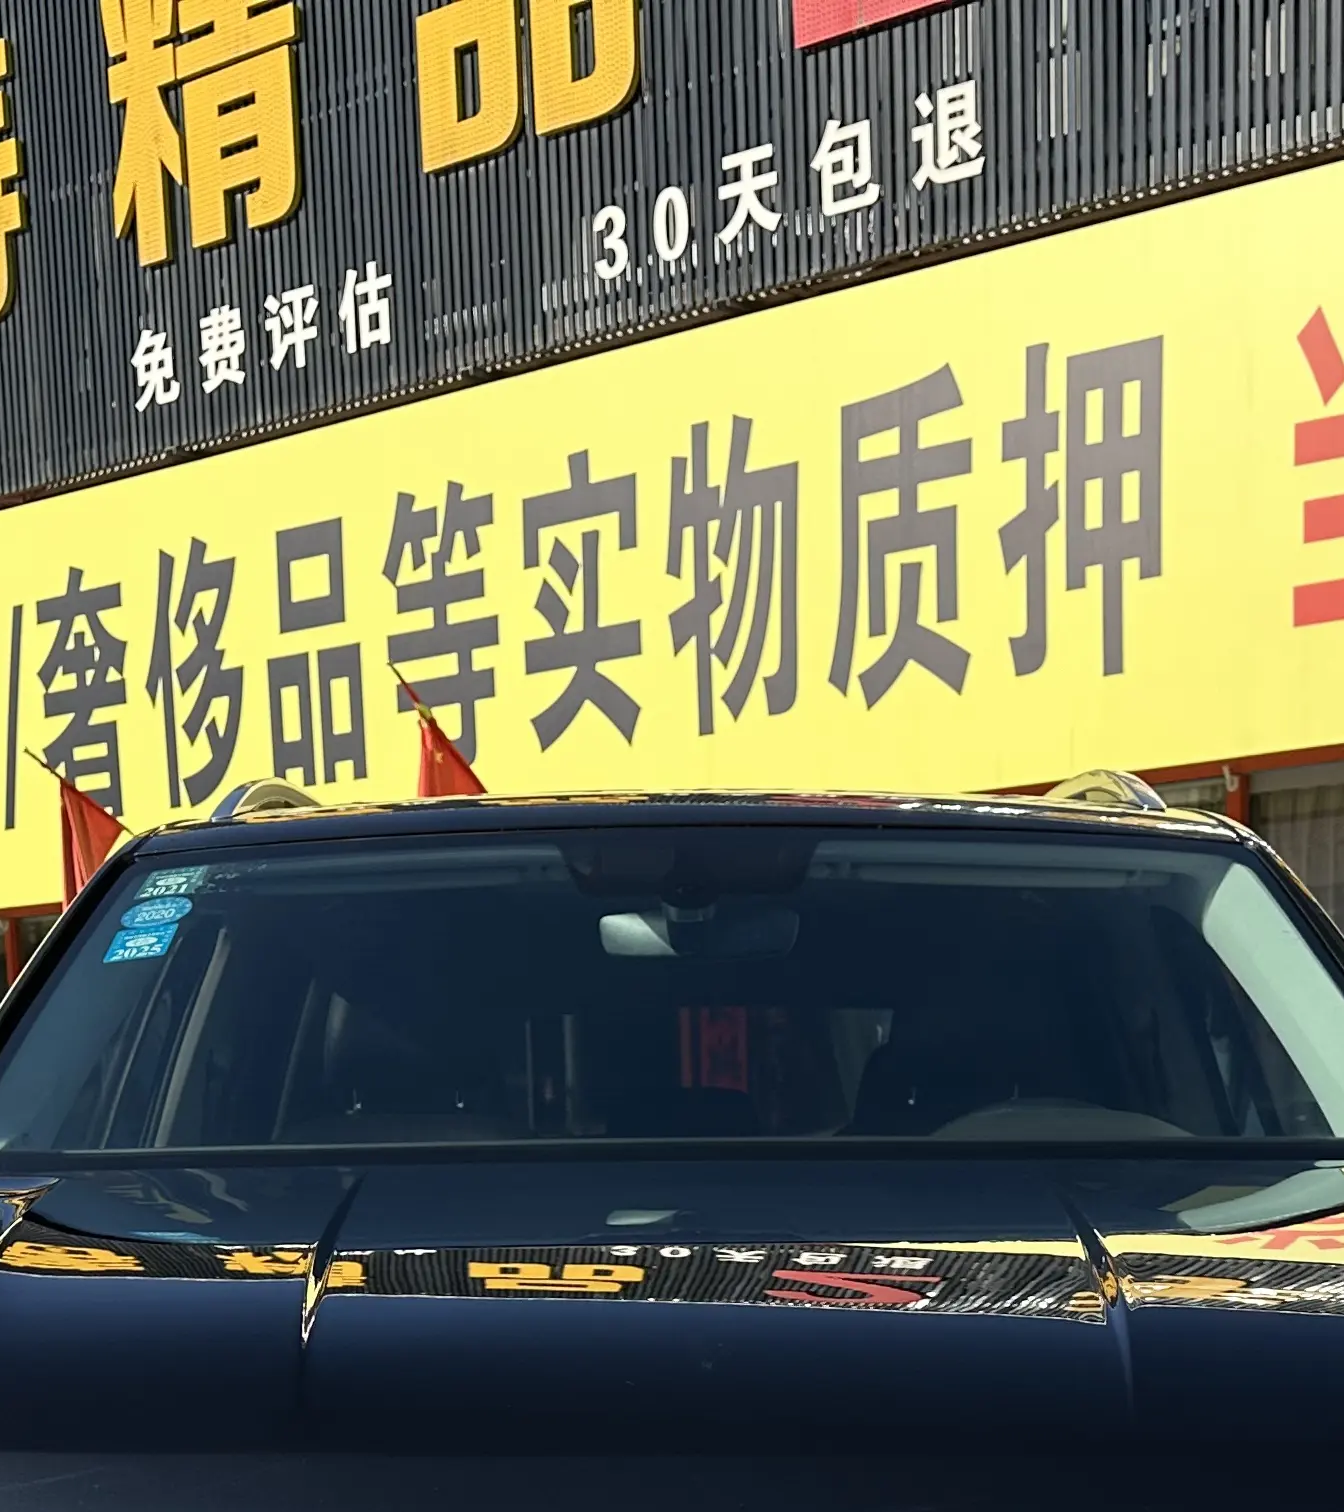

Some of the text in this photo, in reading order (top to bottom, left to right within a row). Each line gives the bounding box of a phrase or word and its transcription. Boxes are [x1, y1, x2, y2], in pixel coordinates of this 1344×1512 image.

[130, 262, 394, 412] 免费评估
[591, 80, 986, 281] 30天包退
[139, 883, 189, 898] 2021
[133, 908, 177, 923] 2020
[109, 944, 164, 961] 2025
